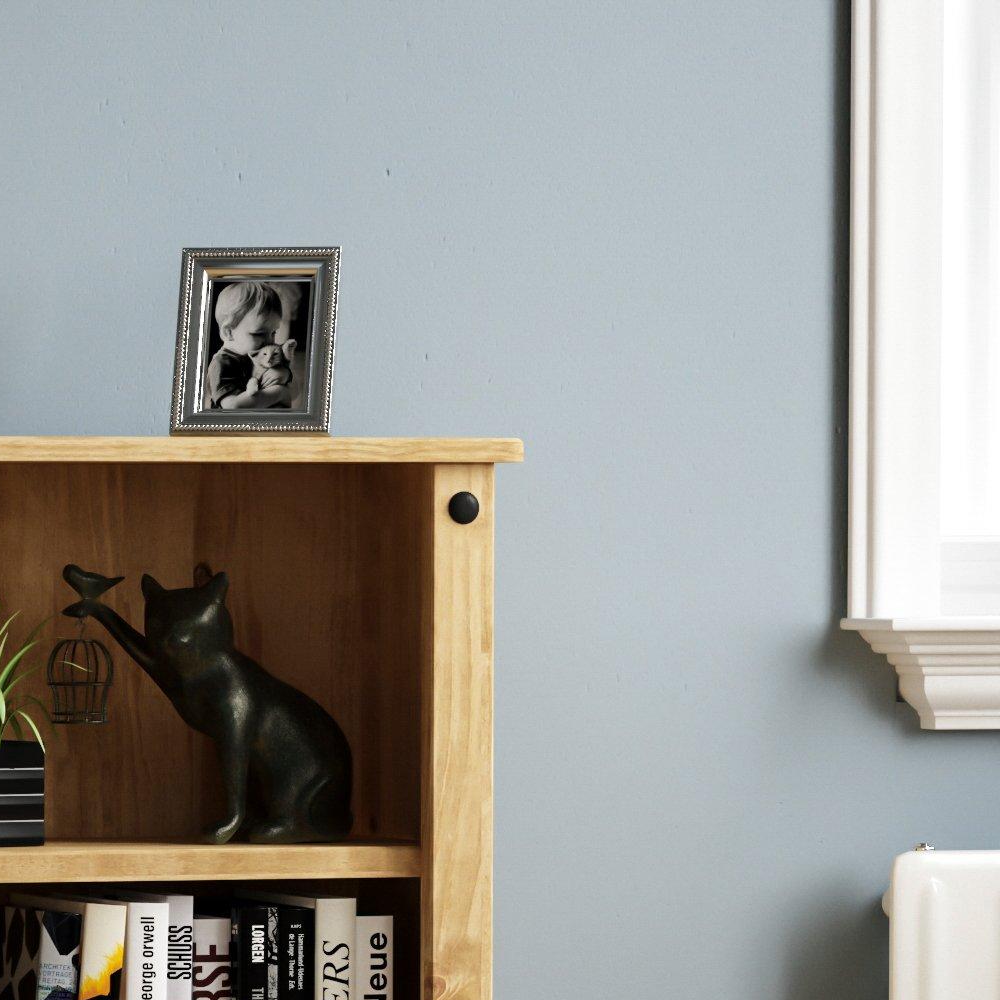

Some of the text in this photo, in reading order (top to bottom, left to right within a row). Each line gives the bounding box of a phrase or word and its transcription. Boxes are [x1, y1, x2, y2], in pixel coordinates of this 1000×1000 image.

[140, 916, 155, 958] orwell
[167, 925, 192, 980] SCHUSS
[251, 924, 265, 963] LORGEN
